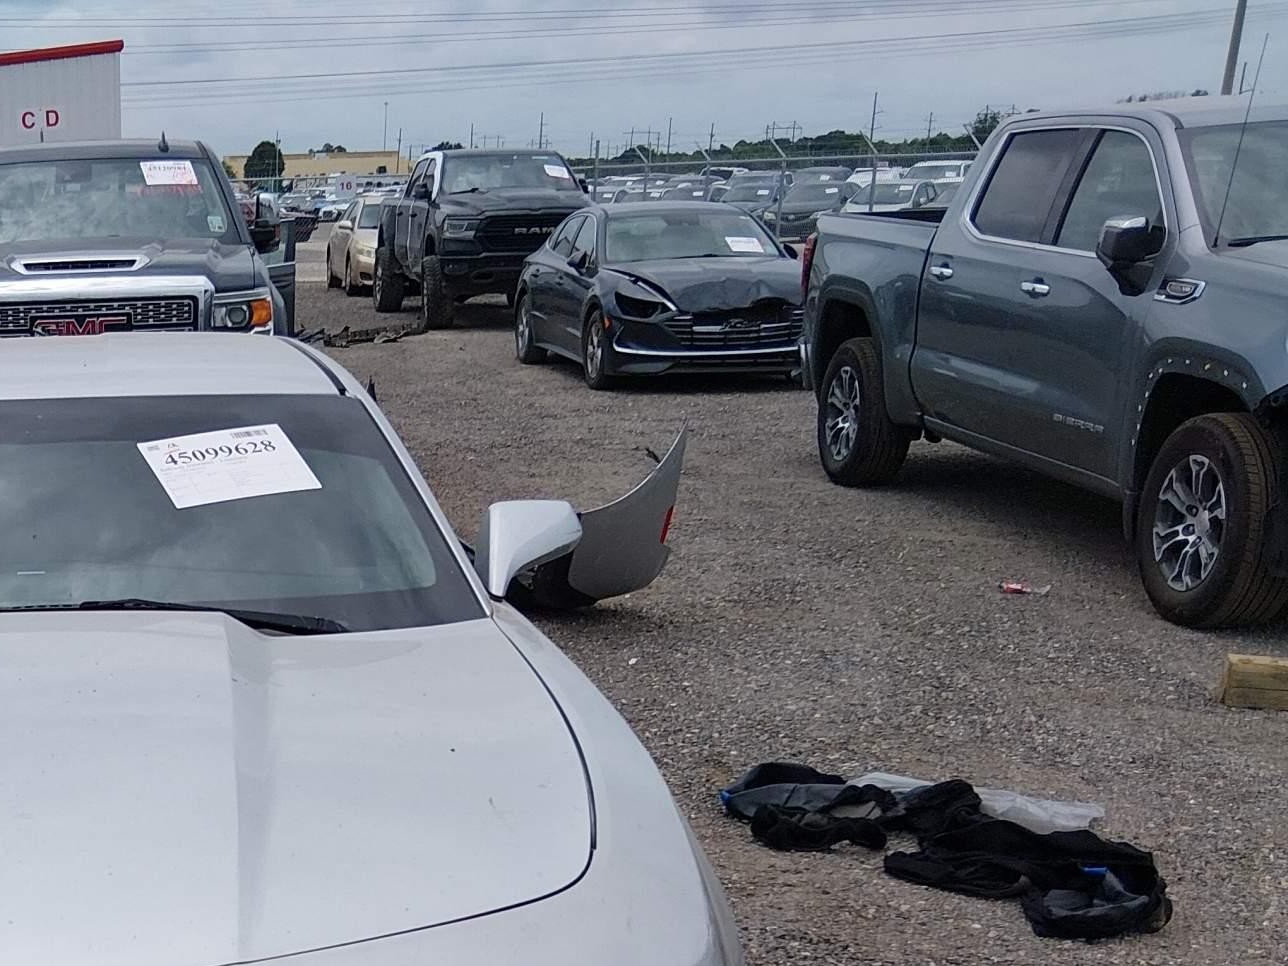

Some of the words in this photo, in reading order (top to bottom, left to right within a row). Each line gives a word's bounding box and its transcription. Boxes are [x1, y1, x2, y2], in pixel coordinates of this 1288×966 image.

[22, 111, 35, 129] C
[46, 110, 59, 127] D
[340, 182, 352, 191] 16
[165, 439, 277, 466] 45099628
